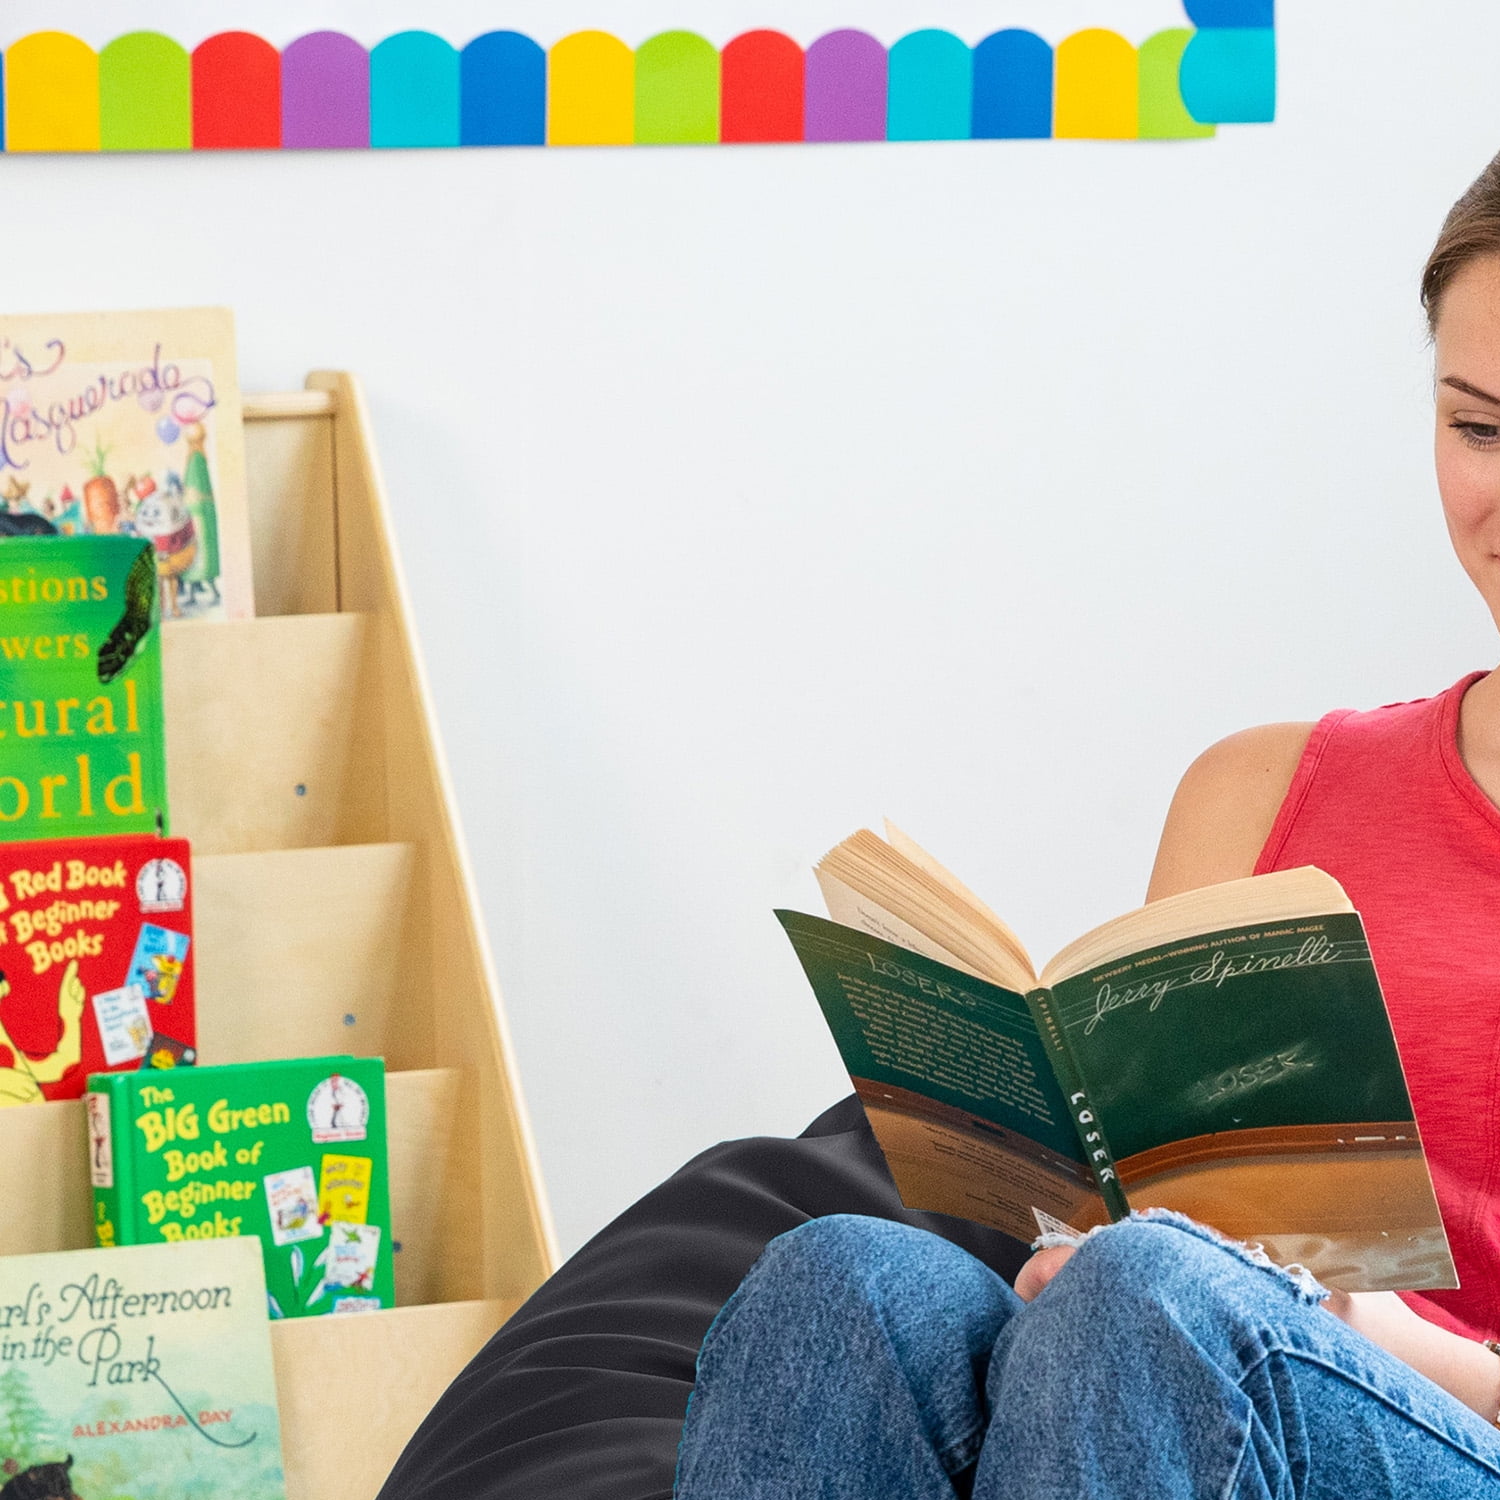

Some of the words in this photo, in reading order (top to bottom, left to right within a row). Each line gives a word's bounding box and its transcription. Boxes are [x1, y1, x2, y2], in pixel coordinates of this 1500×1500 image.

[0, 752, 147, 822] orld
[9, 861, 63, 901] Red
[66, 859, 127, 890] Book
[9, 899, 121, 945] Beginner
[1210, 935, 1248, 948] AUTHOR
[1249, 933, 1262, 941] OF
[25, 929, 105, 975] Books
[1084, 983, 1180, 1036] Jerry
[1190, 935, 1342, 988] Spinelli
[1037, 996, 1064, 1052] SPINELLI
[139, 1085, 175, 1108] The
[135, 1103, 200, 1153] BIG
[207, 1098, 291, 1134] Green
[1070, 1090, 1116, 1184] LOSER
[163, 1140, 228, 1182] Book
[235, 1140, 265, 1165] of
[142, 1180, 257, 1225] Beginner
[160, 1210, 243, 1243] Books
[58, 1272, 233, 1322] Afternoon
[1, 1334, 27, 1361] in
[31, 1325, 73, 1366] the
[72, 1414, 189, 1439] ALEXANDRA
[197, 1408, 234, 1427] DAY
